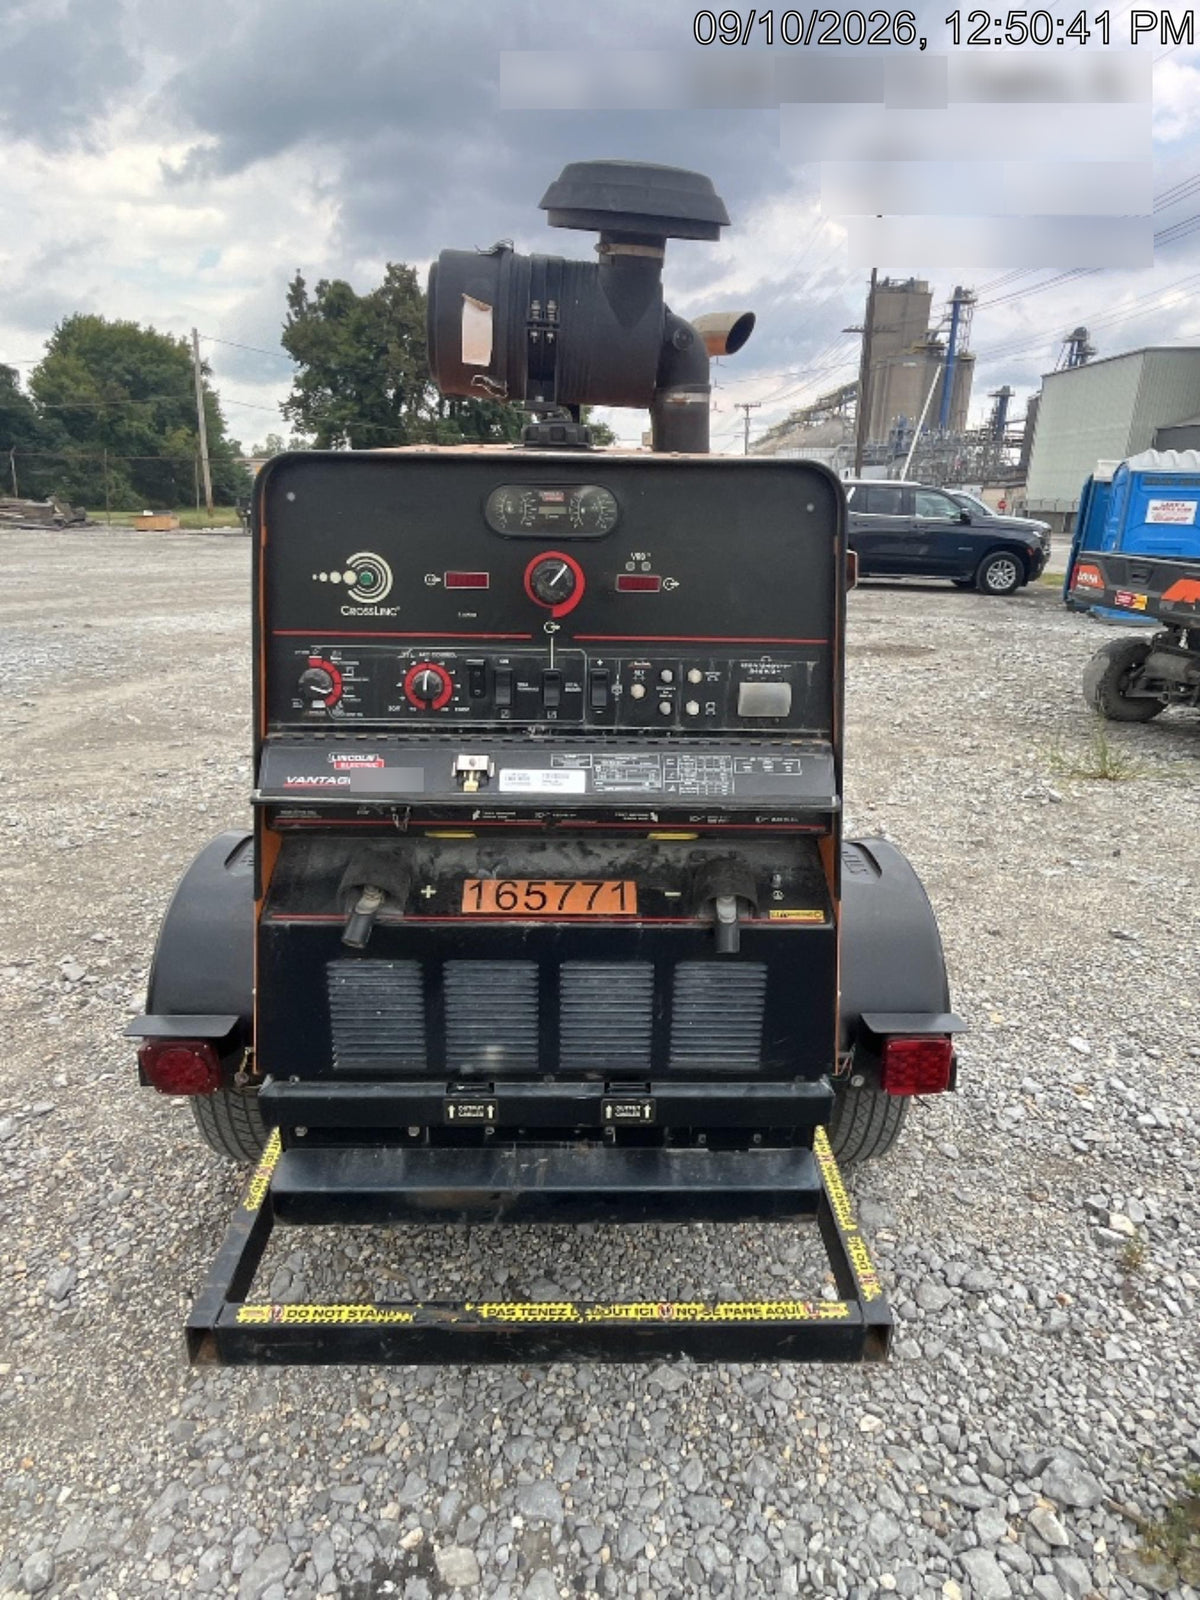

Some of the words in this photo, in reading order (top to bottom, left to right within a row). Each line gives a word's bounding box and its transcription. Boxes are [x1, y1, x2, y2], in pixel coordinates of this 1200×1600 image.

[286, 776, 350, 785] VANTAG
[469, 881, 627, 911] 165771
[287, 1309, 309, 1318] DO
[312, 1309, 342, 1318] NOT
[486, 1307, 516, 1316] PAS
[519, 1307, 567, 1316] TENEZ
[636, 1307, 654, 1316] ICI
[677, 1308, 698, 1316] NO
